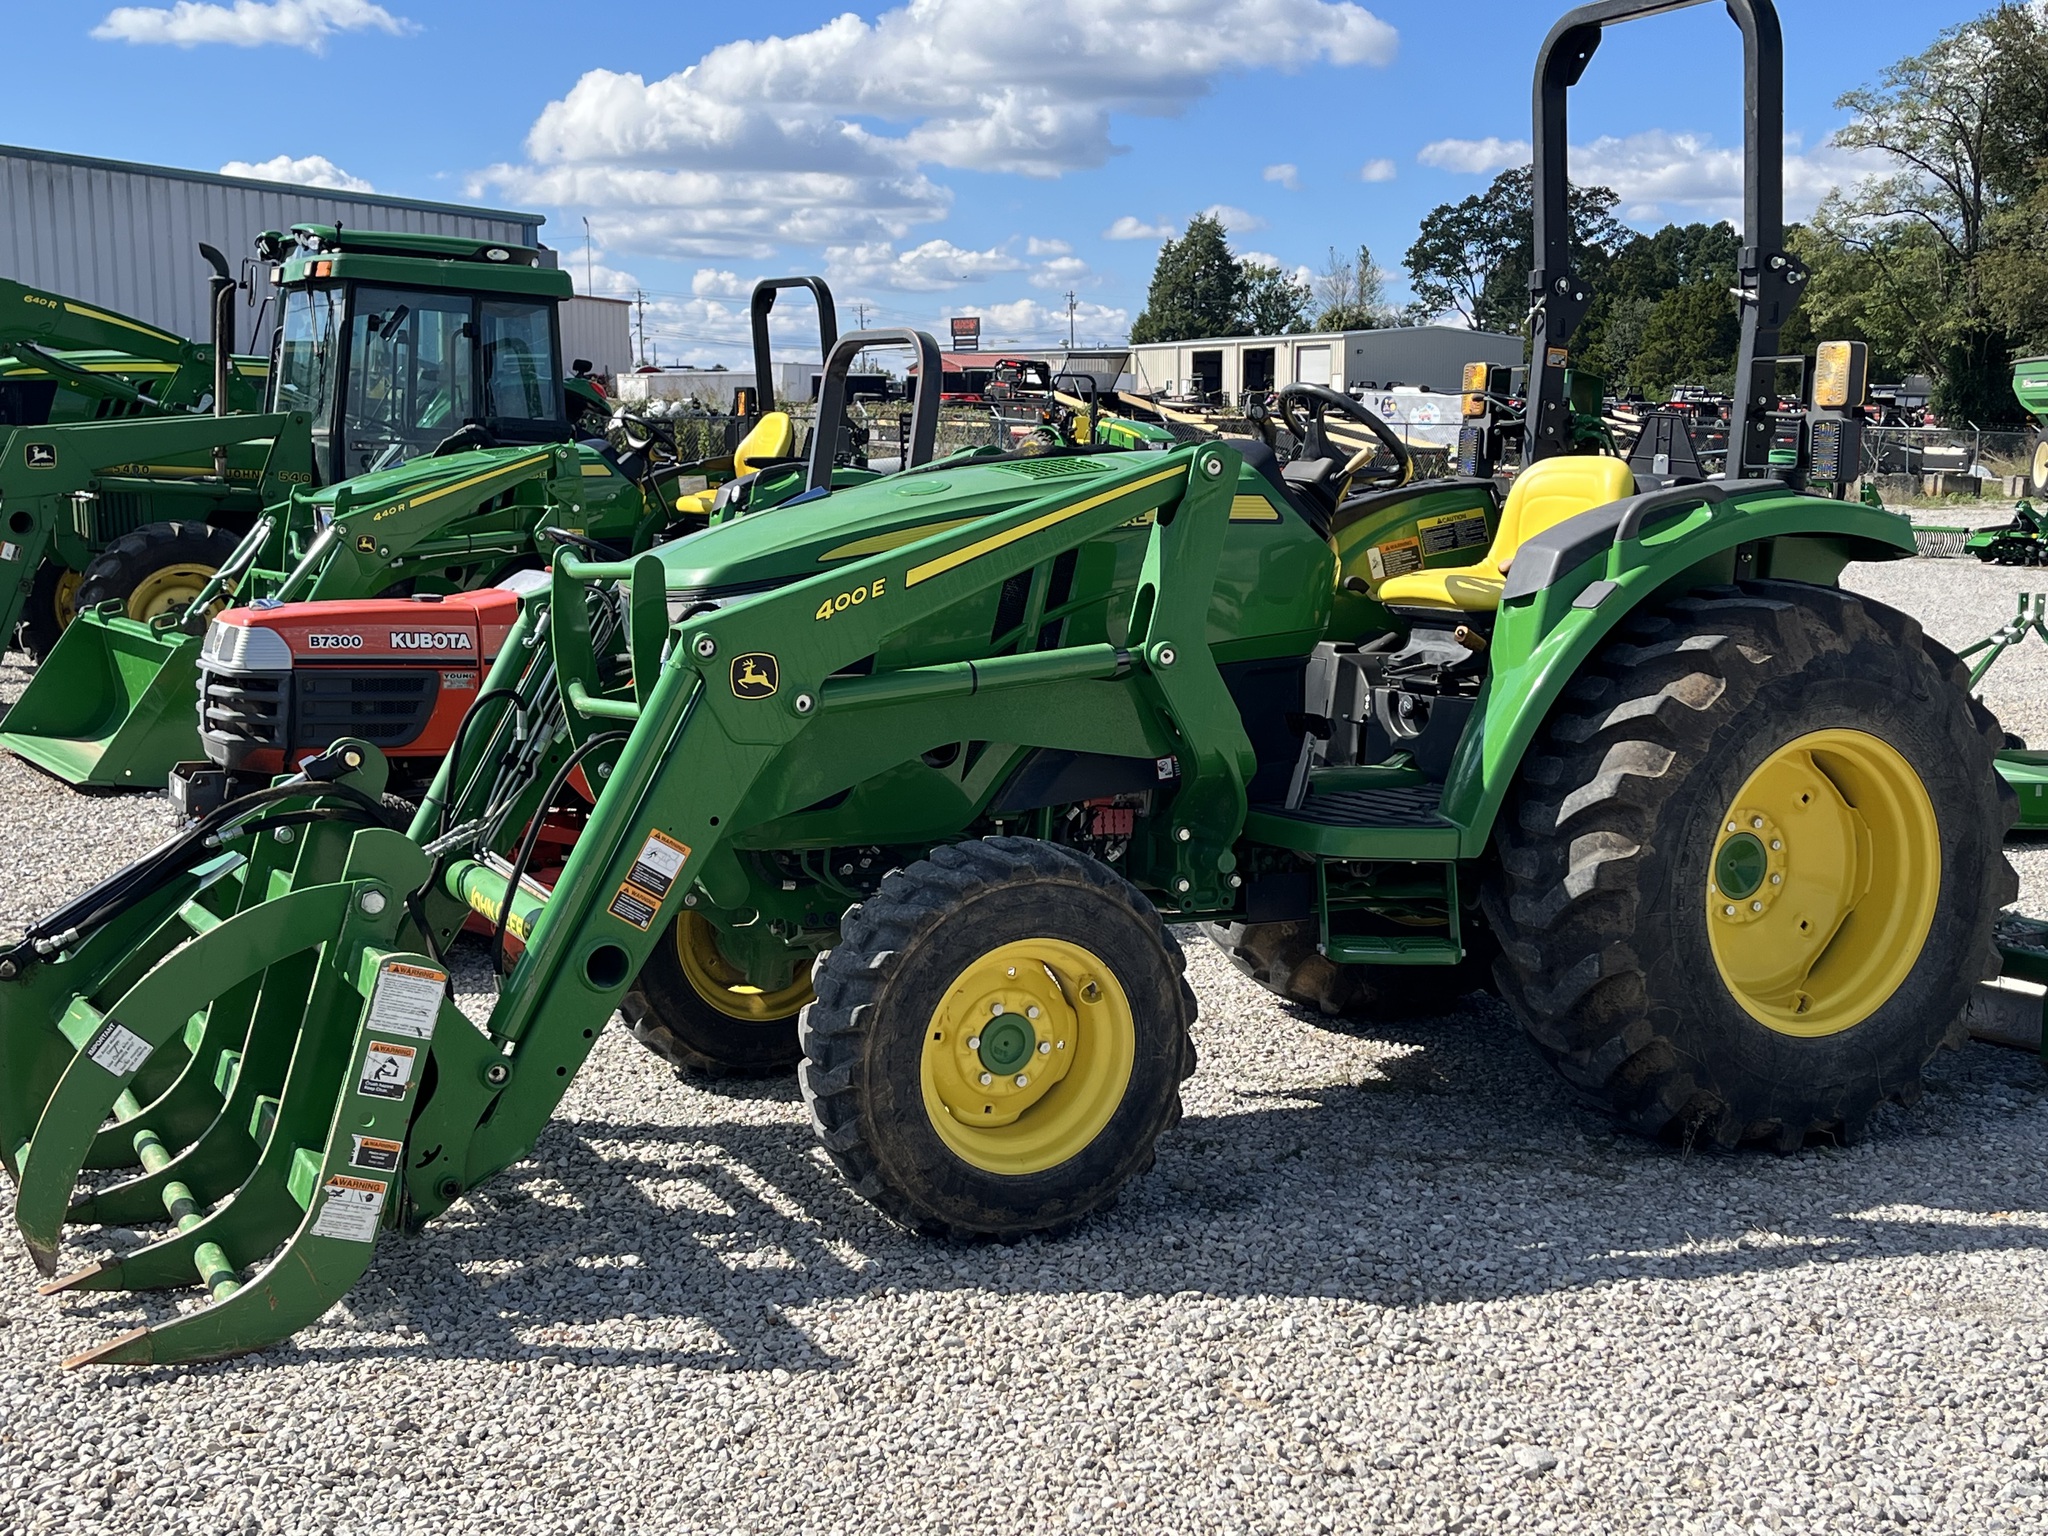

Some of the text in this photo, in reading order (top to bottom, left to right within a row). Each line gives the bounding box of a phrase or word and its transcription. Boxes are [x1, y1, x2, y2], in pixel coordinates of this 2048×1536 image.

[226, 468, 260, 479] JOHN
[278, 470, 312, 483] 540
[1441, 513, 1467, 523] CAUTION
[1390, 540, 1413, 549] WARNING
[310, 632, 472, 650] B7300 KUBOTA
[444, 672, 476, 680] YOUNG
[661, 835, 686, 853] WARNING
[631, 889, 657, 908] WARNING
[400, 967, 435, 979] WARNING
[87, 1022, 116, 1056] IMPORTANT
[380, 1045, 411, 1056] WARNING
[370, 1141, 397, 1150] WARNING
[339, 1178, 380, 1192] WARNING
